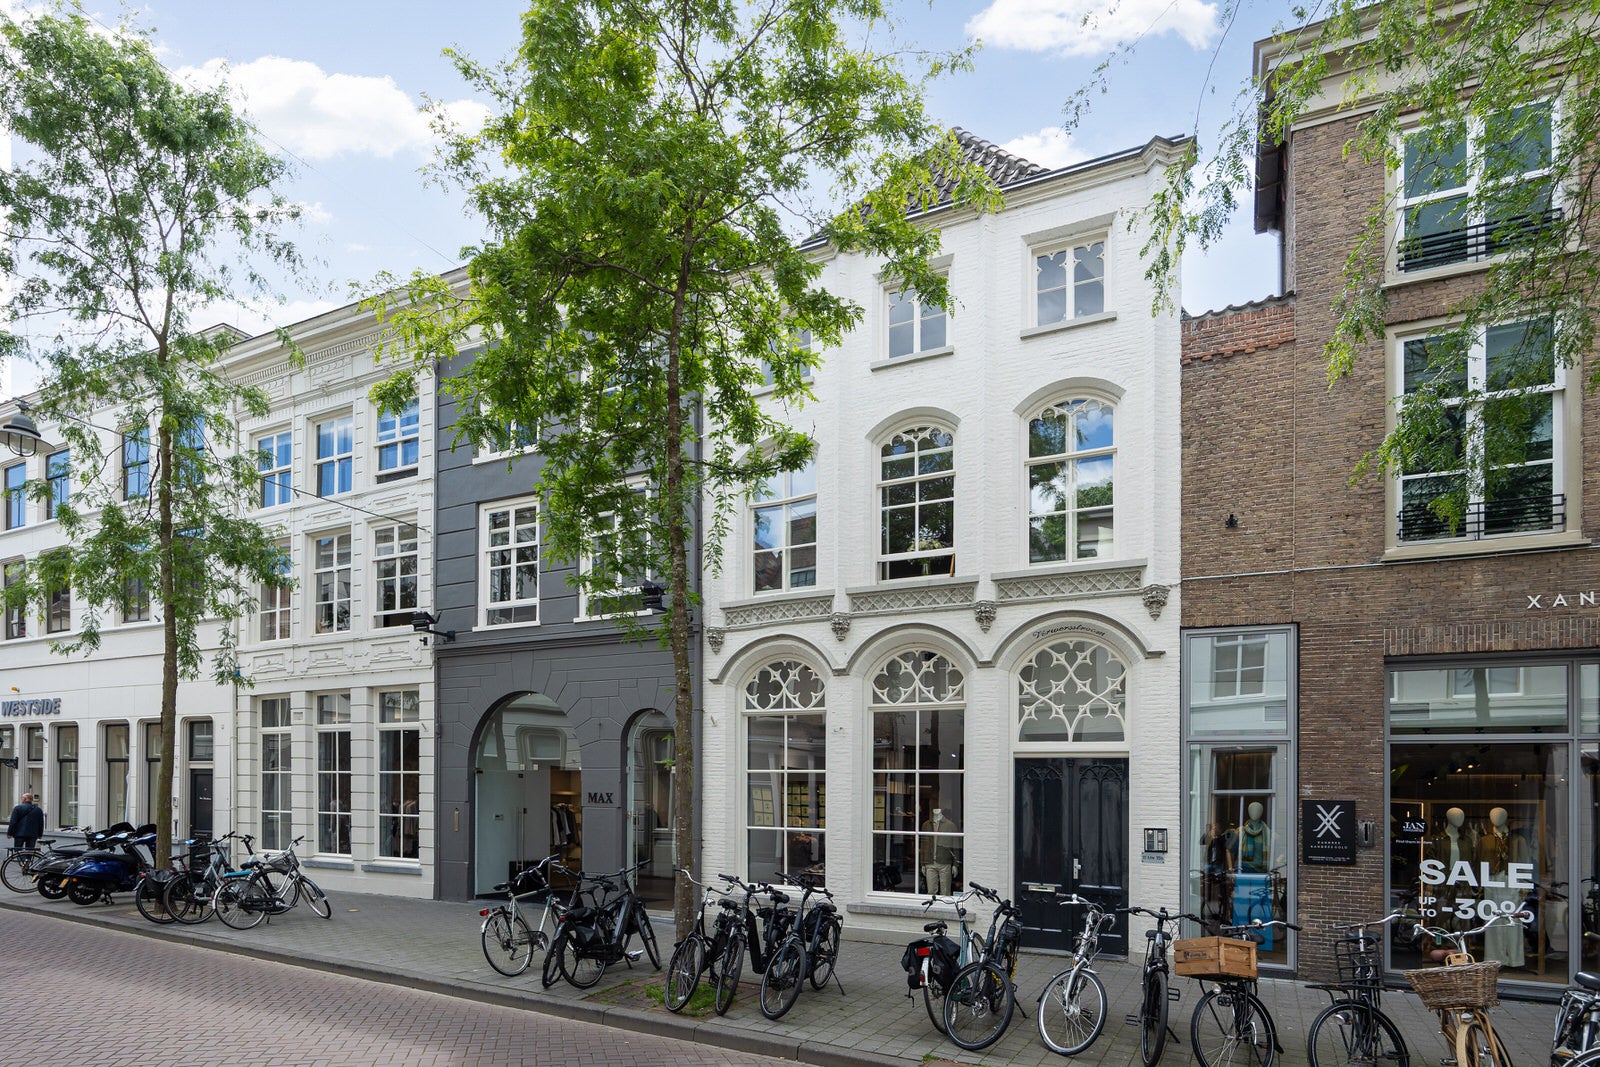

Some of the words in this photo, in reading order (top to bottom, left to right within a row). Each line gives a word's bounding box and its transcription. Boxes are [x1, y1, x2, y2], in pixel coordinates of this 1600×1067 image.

[1526, 591, 1595, 609] XAN
[1, 698, 61, 717] WESTSIDE
[587, 792, 614, 804] MAX
[1402, 821, 1426, 830] JAN
[1418, 859, 1535, 889] SALE
[1418, 896, 1437, 906] UP
[1418, 908, 1437, 918] TO
[1441, 897, 1535, 924] -30%
